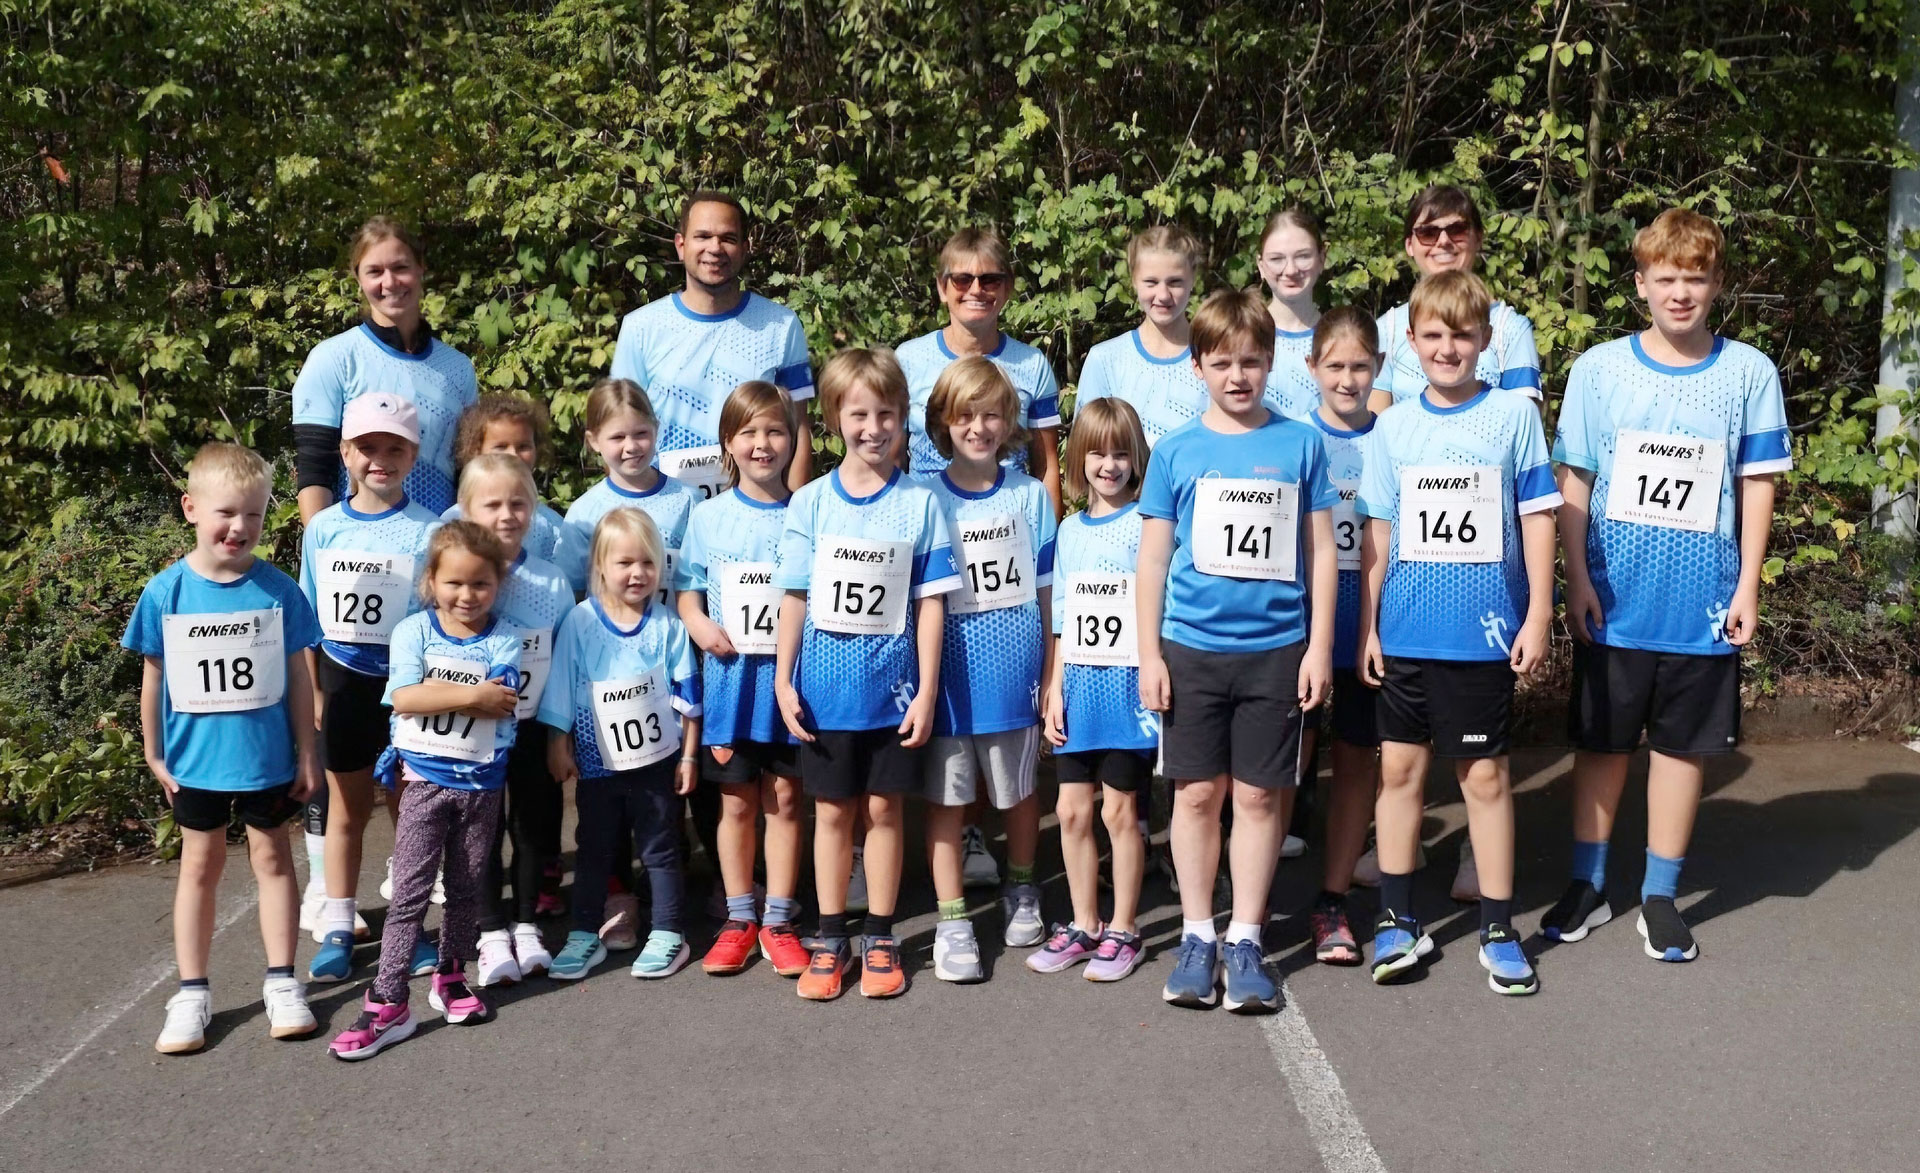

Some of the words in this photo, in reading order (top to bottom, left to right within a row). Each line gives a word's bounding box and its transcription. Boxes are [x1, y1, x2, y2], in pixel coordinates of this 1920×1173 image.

[1637, 474, 1694, 511] 147
[1223, 524, 1272, 559] 141
[1418, 510, 1477, 543] 146
[966, 556, 1021, 594] 154
[333, 591, 383, 625] 128
[832, 580, 886, 616] 152
[741, 604, 781, 636] 14
[1076, 614, 1122, 647] 139
[197, 656, 254, 693] 118
[609, 712, 662, 752] 103
